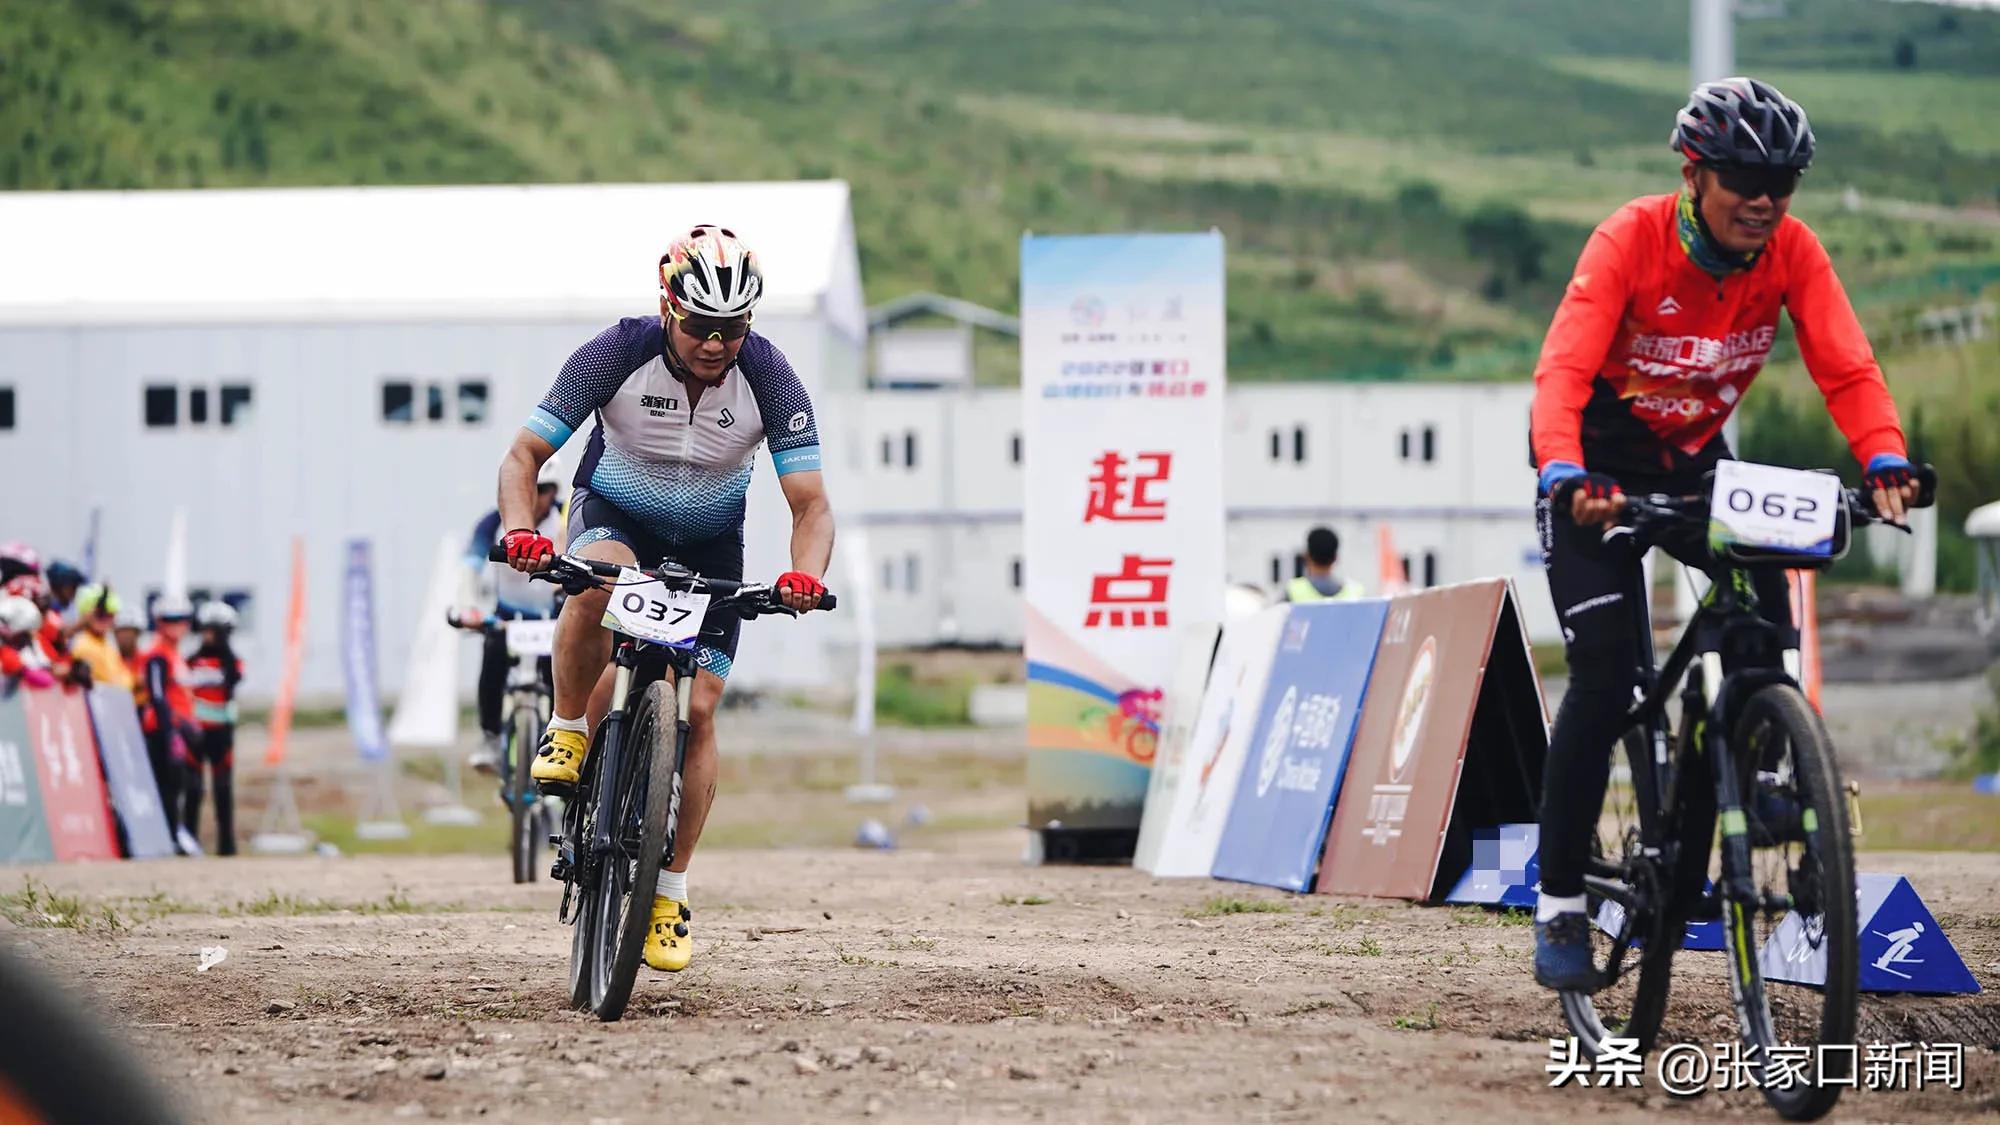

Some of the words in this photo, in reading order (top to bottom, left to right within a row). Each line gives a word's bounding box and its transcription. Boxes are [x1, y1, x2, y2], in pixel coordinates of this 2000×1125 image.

[639, 394, 679, 411] 张家口
[1727, 487, 1819, 524] 062
[1083, 450, 1175, 630] 起点
[621, 592, 693, 626] 037
